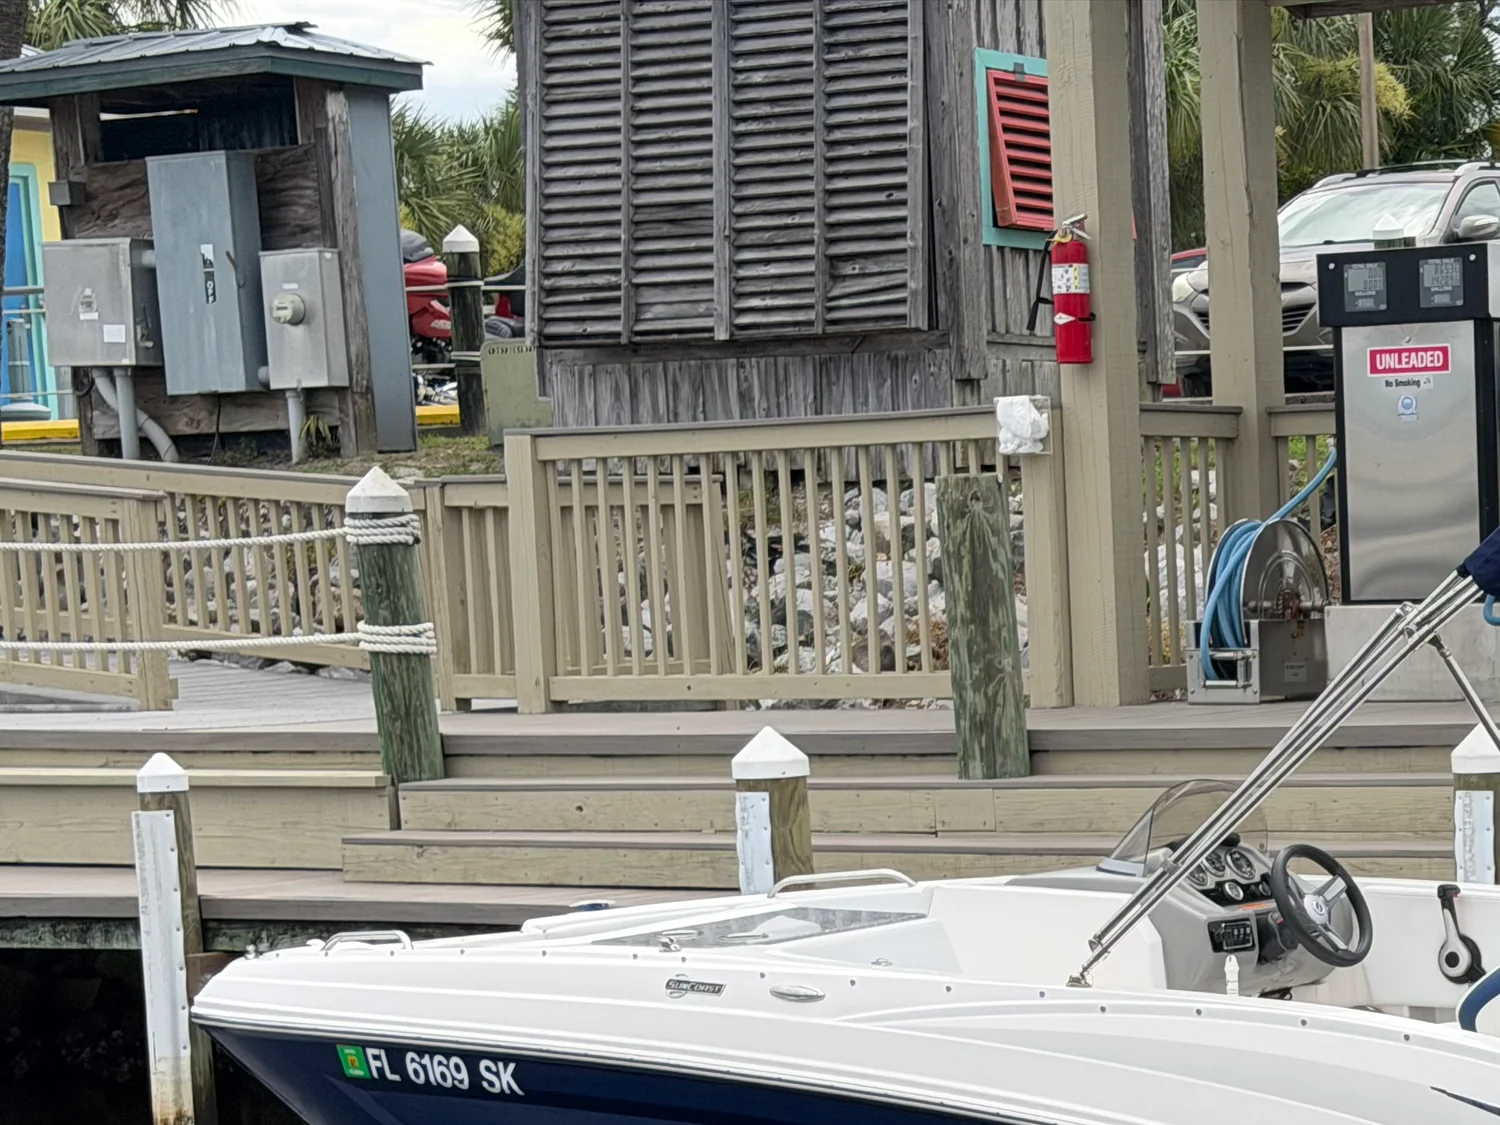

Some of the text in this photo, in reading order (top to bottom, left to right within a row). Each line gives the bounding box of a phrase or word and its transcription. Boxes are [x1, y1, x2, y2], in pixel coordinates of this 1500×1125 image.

[1376, 350, 1444, 370] UNLEADED
[1385, 378, 1421, 388] No Smoking
[365, 1047, 525, 1096] FL 6169 SK
